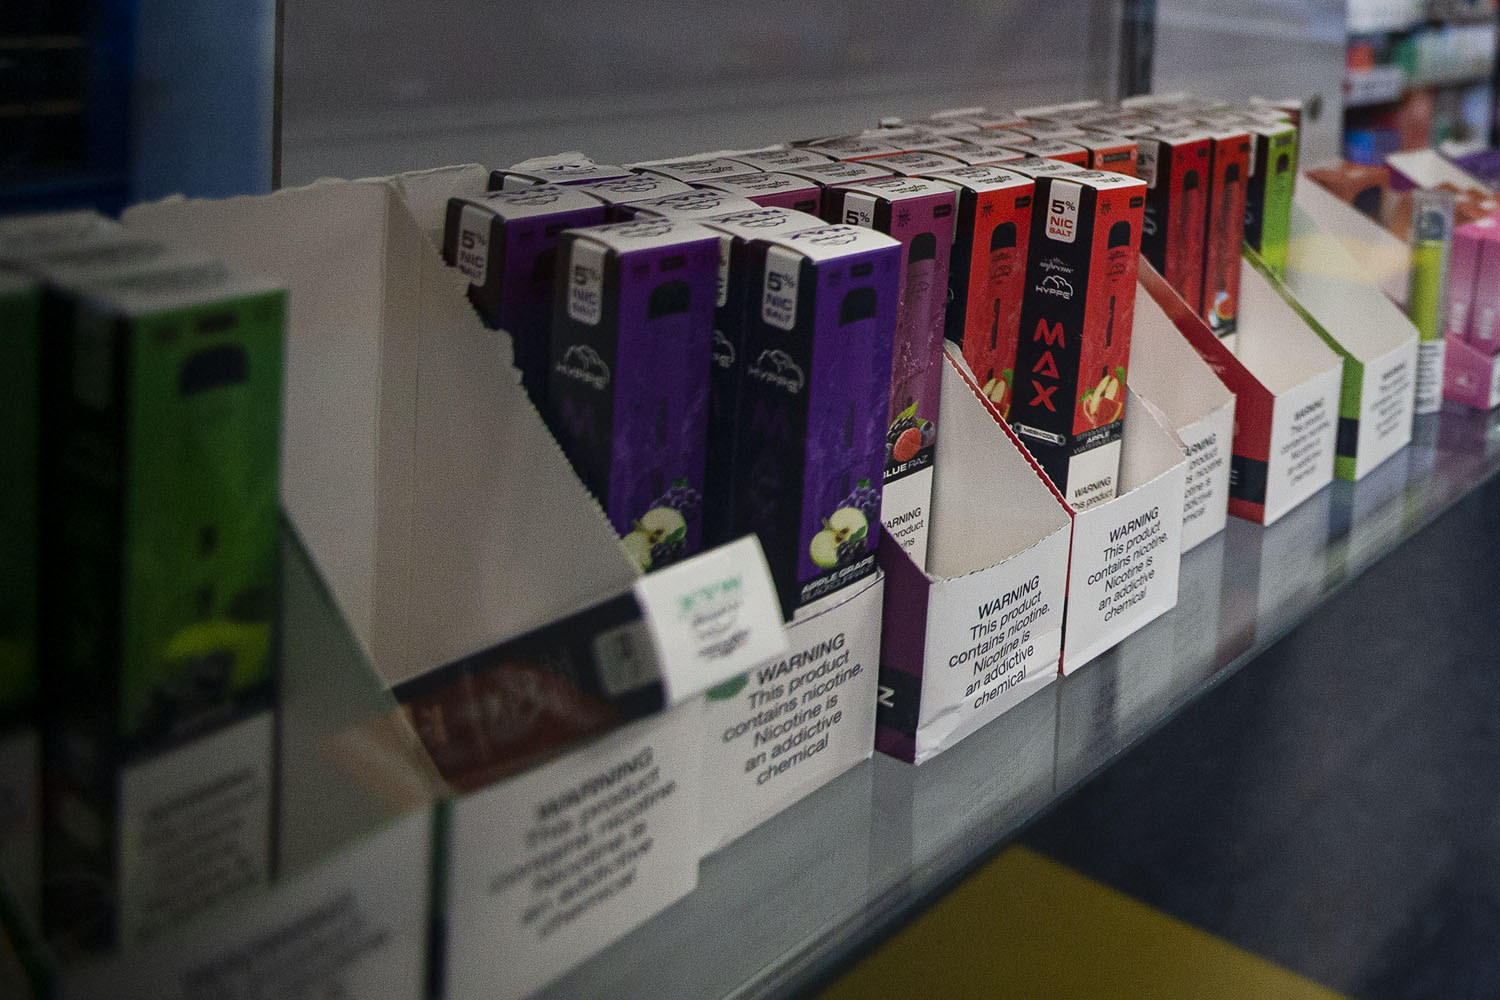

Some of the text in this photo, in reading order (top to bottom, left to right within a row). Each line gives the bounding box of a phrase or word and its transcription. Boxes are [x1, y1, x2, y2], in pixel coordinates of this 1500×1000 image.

[846, 210, 871, 225] 5%
[1050, 216, 1073, 229] NIC
[1051, 200, 1076, 215] 5%
[1049, 228, 1072, 238] SALT
[765, 293, 793, 311] NIC
[767, 271, 795, 292] 5%
[1035, 285, 1071, 300] HYPPE
[908, 454, 929, 470] RAZ
[1074, 475, 1112, 498] WARNING
[1086, 488, 1114, 508] product
[1103, 520, 1161, 562] This product
[1109, 506, 1160, 543] WARNING
[801, 570, 839, 595] APPLE
[838, 554, 875, 578] GRAPE
[1087, 531, 1169, 586] contains nicotine.
[1104, 555, 1153, 593] Nicotine is
[978, 575, 1040, 619] WARNING
[1098, 568, 1155, 612] an addictive
[1104, 586, 1147, 622] chemical
[948, 603, 1050, 668] contains nicotine.
[970, 591, 1042, 641] This product
[756, 633, 845, 685] WARNING
[965, 644, 1034, 698] an addictive
[973, 629, 1031, 676] Nicotine is
[749, 649, 850, 710] This product
[974, 665, 1027, 710] chemical
[723, 698, 798, 743] contains
[802, 663, 864, 703] nicotine.
[754, 694, 839, 747] Nicotine is
[745, 710, 842, 773] an addictive
[757, 732, 829, 786] chemical
